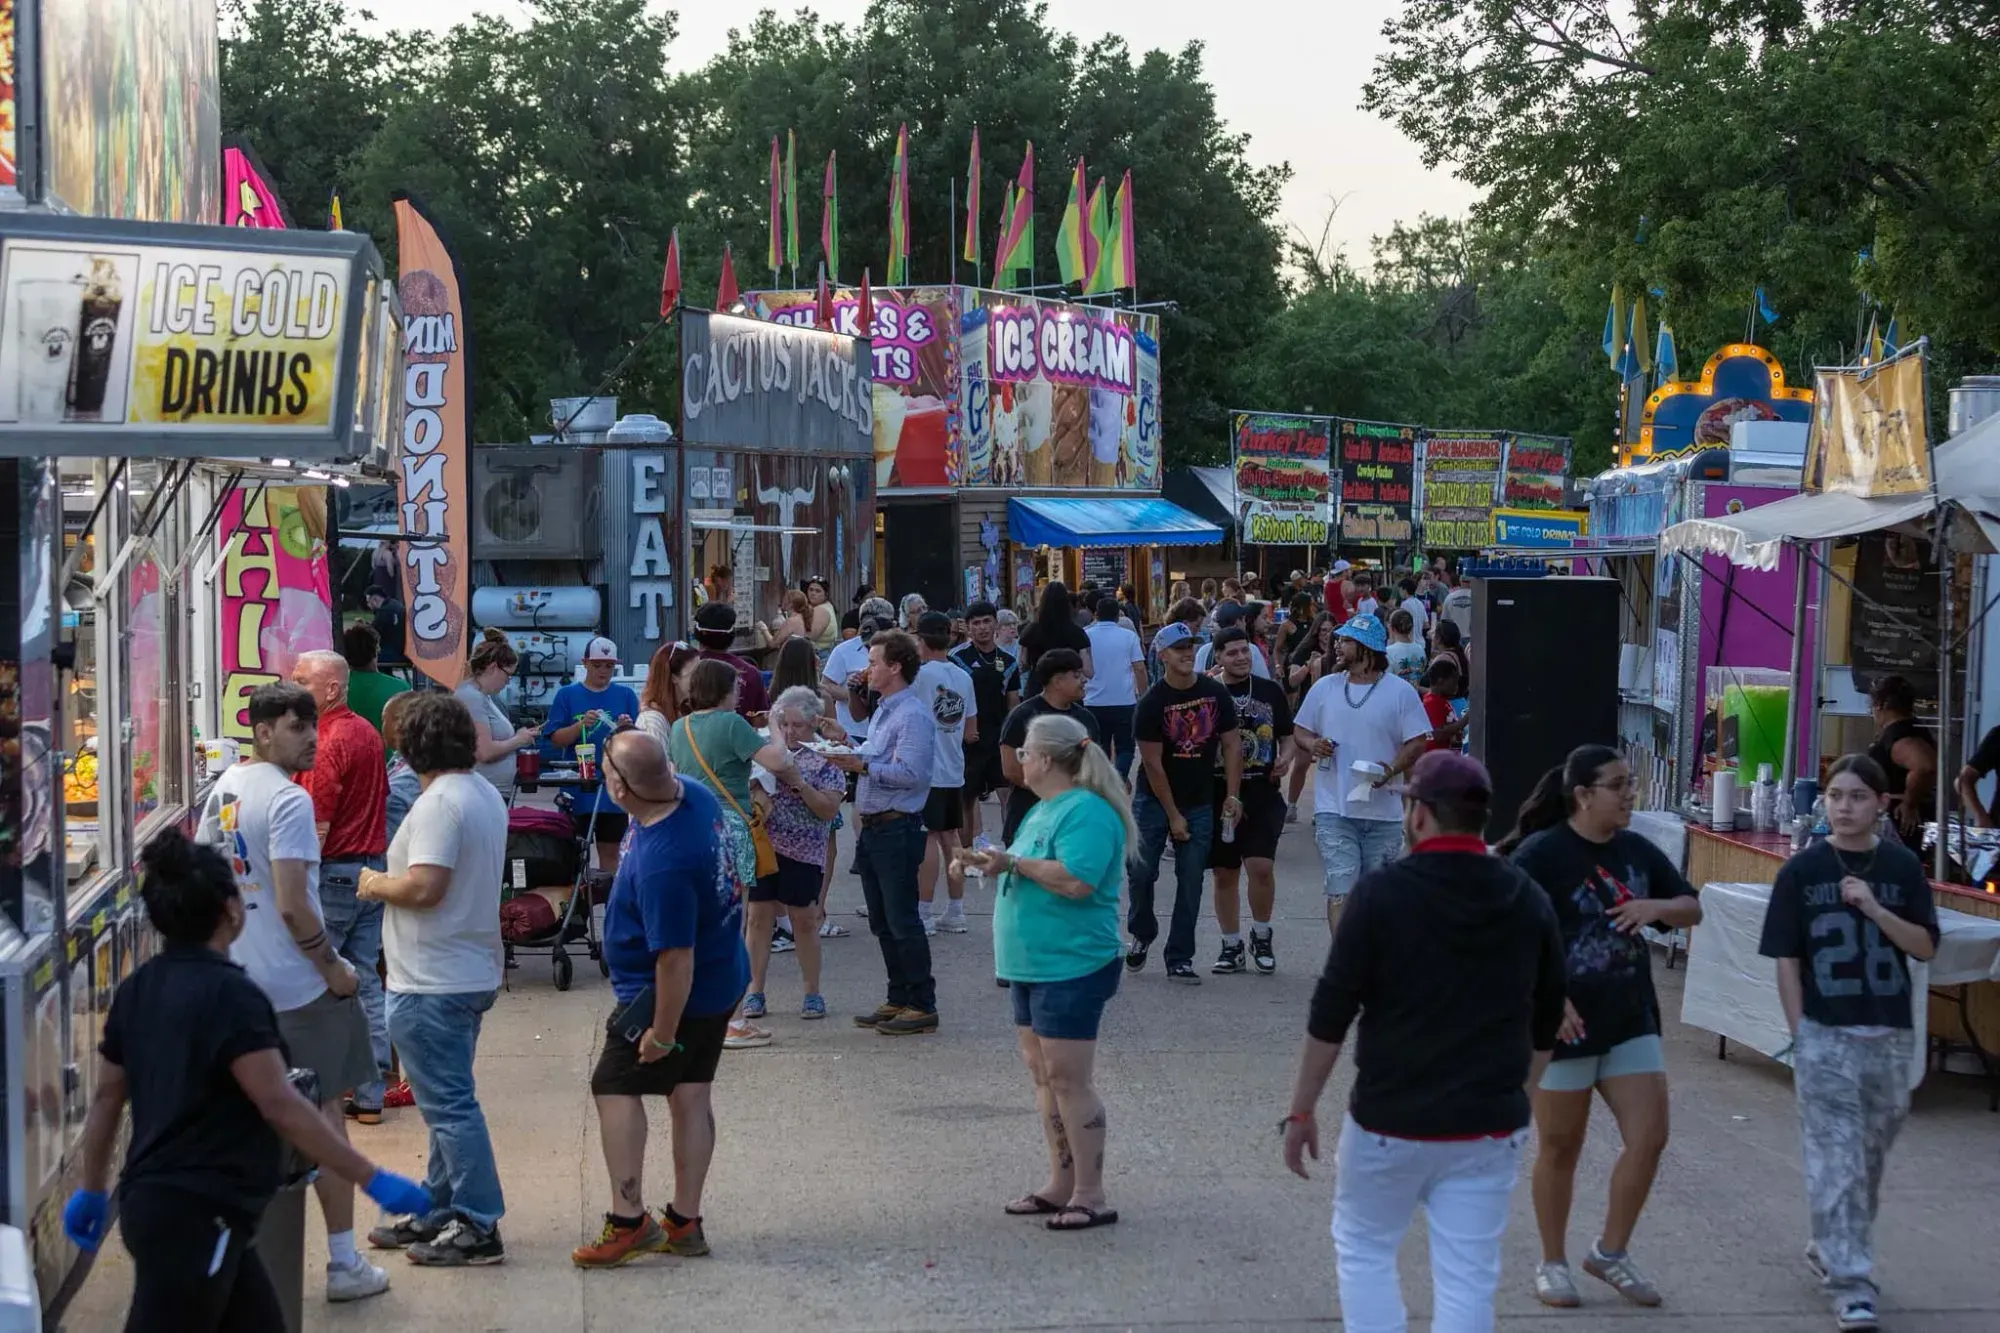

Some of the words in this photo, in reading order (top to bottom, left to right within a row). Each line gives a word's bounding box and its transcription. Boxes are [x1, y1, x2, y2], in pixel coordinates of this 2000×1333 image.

[150, 262, 222, 335] ICE
[231, 268, 338, 340] COLD
[162, 347, 312, 416] DRINKS
[683, 329, 792, 420] CACTUS
[797, 334, 873, 436] JACKS
[995, 318, 1037, 373] ICE
[1041, 319, 1132, 386] CREAM
[1240, 427, 1292, 454] Turkey
[629, 455, 673, 640] EAT
[1252, 513, 1295, 543] Ribbon
[1295, 513, 1326, 543] Fries
[1811, 911, 1903, 996] 26
